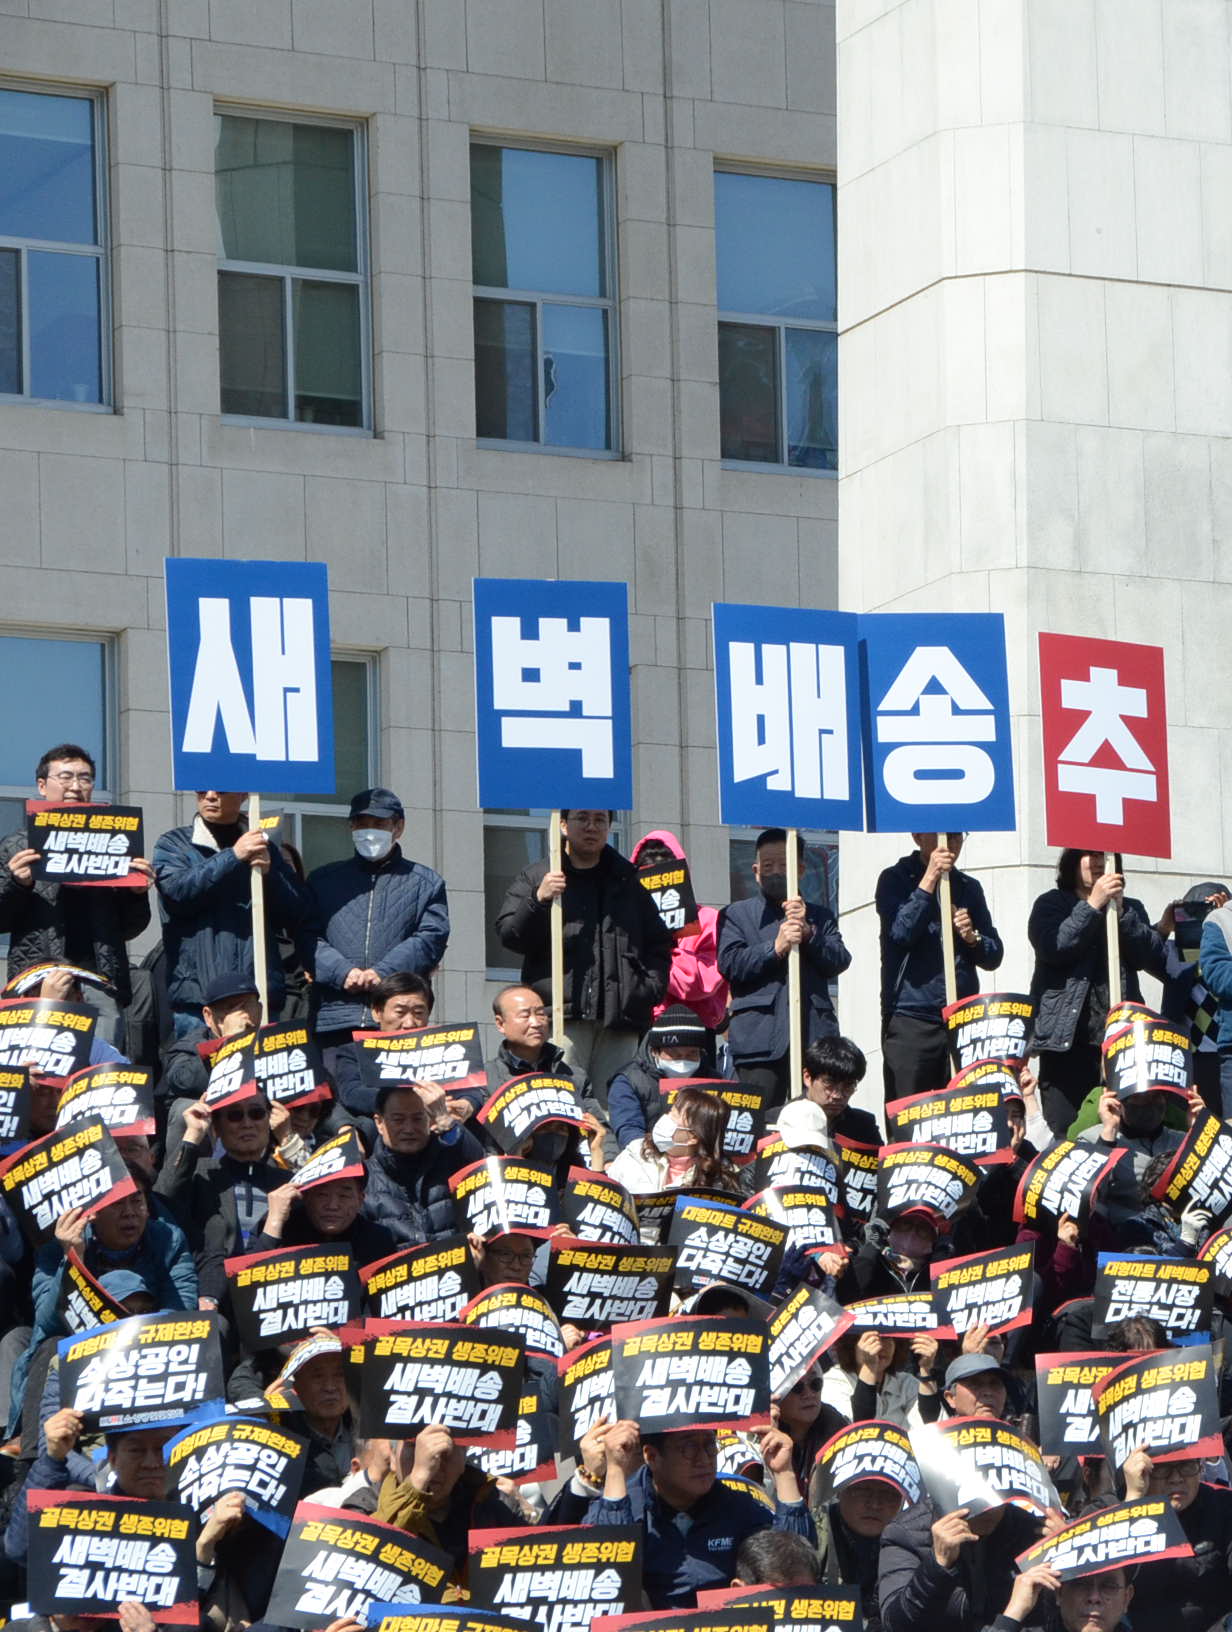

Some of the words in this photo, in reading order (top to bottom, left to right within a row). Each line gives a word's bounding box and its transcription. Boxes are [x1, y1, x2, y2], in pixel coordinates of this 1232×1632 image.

[183, 596, 318, 762] 새
[490, 616, 615, 779] 벽
[729, 641, 849, 800] 배
[877, 646, 996, 805] 송
[1057, 667, 1156, 824] 추
[34, 812, 86, 828] 골목상권
[89, 814, 139, 831] 생존위협
[43, 830, 130, 855] 새벽배송
[45, 853, 131, 876] 결사반대
[948, 1006, 985, 1030] 골목상권
[987, 1002, 1032, 1018] 생존위협
[957, 1018, 1026, 1048] 새벽배송
[262, 1029, 308, 1052] 생존위협
[363, 1036, 417, 1050] 골목상권
[420, 1028, 475, 1046] 생존위협
[375, 1044, 466, 1069] 새벽배송
[961, 1037, 1027, 1068] 결사반대
[1152, 1029, 1190, 1049] 생존위협
[91, 1071, 147, 1086] 생존위협
[380, 1060, 470, 1082] 결사반대
[487, 1083, 528, 1123] 골목상권
[530, 1076, 575, 1091] 생존위협
[503, 1088, 576, 1127] 새벽배송
[897, 1101, 946, 1126] 골목상권
[949, 1093, 999, 1112] 생존위협
[513, 1102, 583, 1137] 결사반대
[912, 1111, 993, 1144] 새벽배송
[2, 1151, 49, 1190] 골목상권
[50, 1124, 103, 1159] 생존위협
[883, 1151, 932, 1168] 골목상권
[934, 1154, 977, 1186] 생존위협
[22, 1148, 103, 1209] 새벽배송
[504, 1166, 553, 1188] 생존위협
[572, 1181, 622, 1208] 골목상권
[888, 1166, 964, 1201] 새벽배송
[32, 1166, 113, 1229] 결사반대
[888, 1185, 959, 1219] 결사반대
[680, 1206, 736, 1228] 대형마트
[740, 1217, 785, 1244] 규제완화
[557, 1250, 616, 1271] 골목상권
[618, 1255, 673, 1273] 생존위협
[684, 1226, 772, 1266] 소상공인
[236, 1263, 295, 1287] 골목상권
[299, 1256, 349, 1273] 생존위협
[367, 1264, 408, 1295] 골목상권
[411, 1246, 466, 1277] 생존위협
[562, 1272, 658, 1300] 새벽배송
[676, 1250, 768, 1289] 다죽는다!
[938, 1266, 984, 1289] 골목상권
[985, 1253, 1031, 1277] 생존위협
[1104, 1262, 1156, 1278] 대형마트
[1156, 1265, 1210, 1284] 새벽배송
[252, 1275, 345, 1311] 새벽배송
[380, 1270, 461, 1317] 새벽배송
[562, 1296, 657, 1320] 결사반대
[947, 1275, 1022, 1311] 새벽배송
[1111, 1280, 1200, 1306] 전통시장
[139, 1319, 211, 1345] 규제완화
[259, 1301, 349, 1337] 결사반대
[950, 1296, 1023, 1334] 결사반대
[374, 1336, 450, 1361] 골목상권
[452, 1340, 519, 1368] 생존위협
[623, 1335, 695, 1358] 골목상권
[698, 1331, 763, 1354] 생존위협
[78, 1344, 200, 1385] 소상공인
[383, 1362, 503, 1400] 새벽배송
[564, 1349, 611, 1387] 골목상권
[635, 1355, 753, 1387] 새벽배송
[1141, 1361, 1207, 1388] 생존위협
[72, 1372, 207, 1413] 다죽는다!
[640, 1387, 756, 1418] 결사반대
[384, 1394, 504, 1434] 결사반대
[169, 1424, 229, 1466] 대형마트
[232, 1424, 303, 1459] 규제완화
[177, 1442, 289, 1489] 소상공인
[39, 1507, 116, 1531] 골목상권
[119, 1516, 190, 1540] 생존위협
[1096, 1502, 1165, 1526] 생존위협
[51, 1534, 177, 1573] 새벽배송
[300, 1521, 379, 1555] 골목상권
[379, 1544, 445, 1587] 생존위협
[480, 1544, 556, 1568] 골목상권
[562, 1541, 636, 1564] 생존위협
[54, 1567, 180, 1607] 결사반대
[301, 1551, 422, 1604] 새벽배송
[493, 1569, 621, 1604] 새벽배송
[791, 1599, 856, 1620] 생존위협
